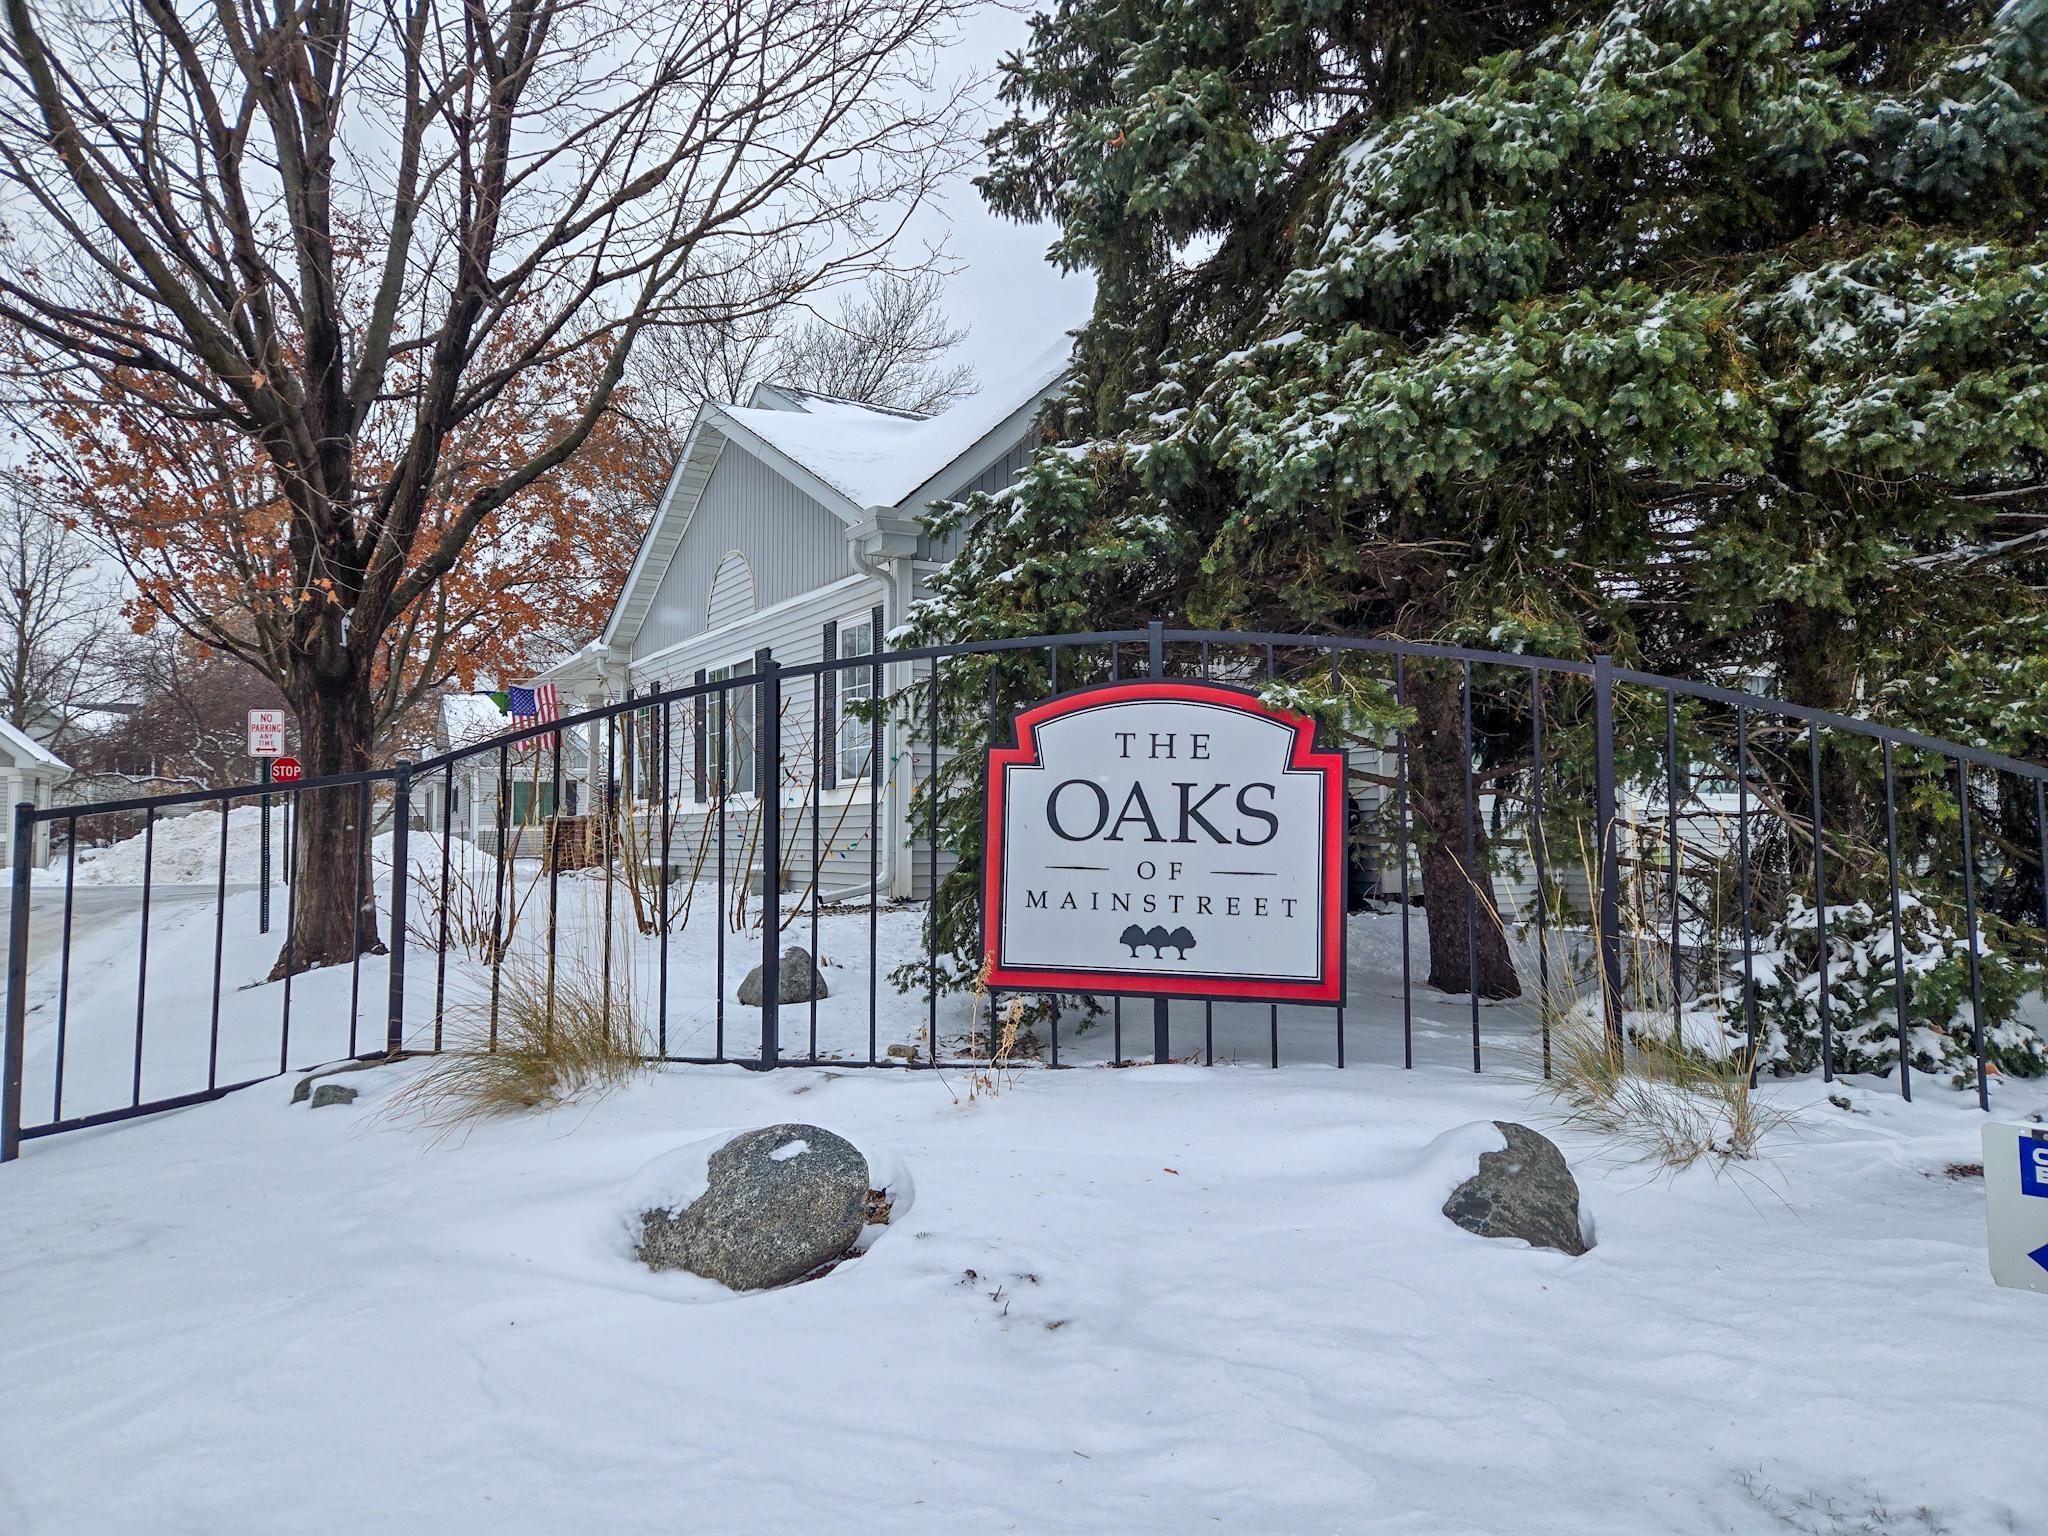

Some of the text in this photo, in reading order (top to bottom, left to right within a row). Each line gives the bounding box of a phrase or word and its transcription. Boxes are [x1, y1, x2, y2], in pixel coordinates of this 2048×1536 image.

[261, 714, 272, 722] NO
[252, 724, 281, 733] PARKING
[1115, 732, 1211, 760] THE
[273, 766, 301, 777] STOP
[1046, 779, 1279, 846] OAKS
[1136, 861, 1183, 880] OF
[1025, 889, 1298, 918] MAINSTREET
